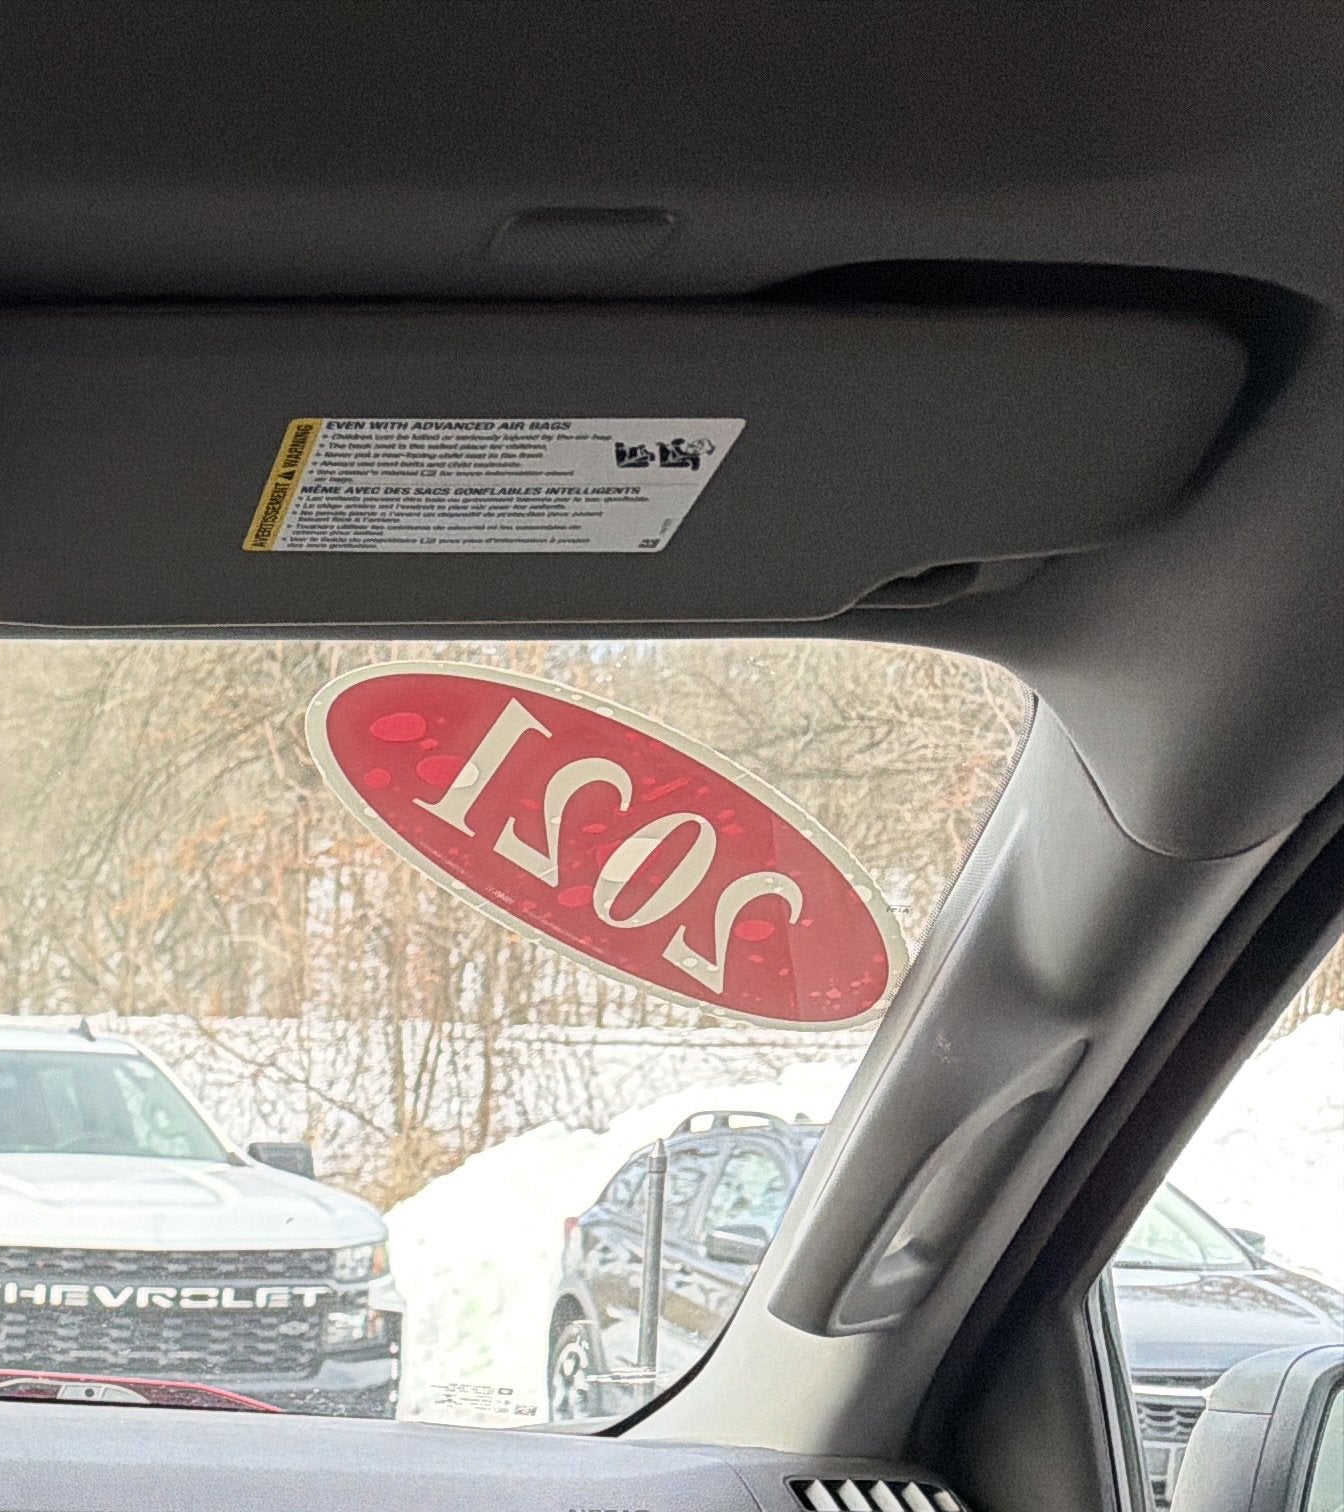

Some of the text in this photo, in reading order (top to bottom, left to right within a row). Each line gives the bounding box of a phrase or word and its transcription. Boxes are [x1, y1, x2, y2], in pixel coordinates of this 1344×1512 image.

[325, 421, 572, 431] EVEN WITH ADVANCED AIR BAGS
[283, 424, 313, 468] WARNING
[301, 485, 641, 496] MÊME AVEC DES SACS GONFLABLES INTELLIGENTS
